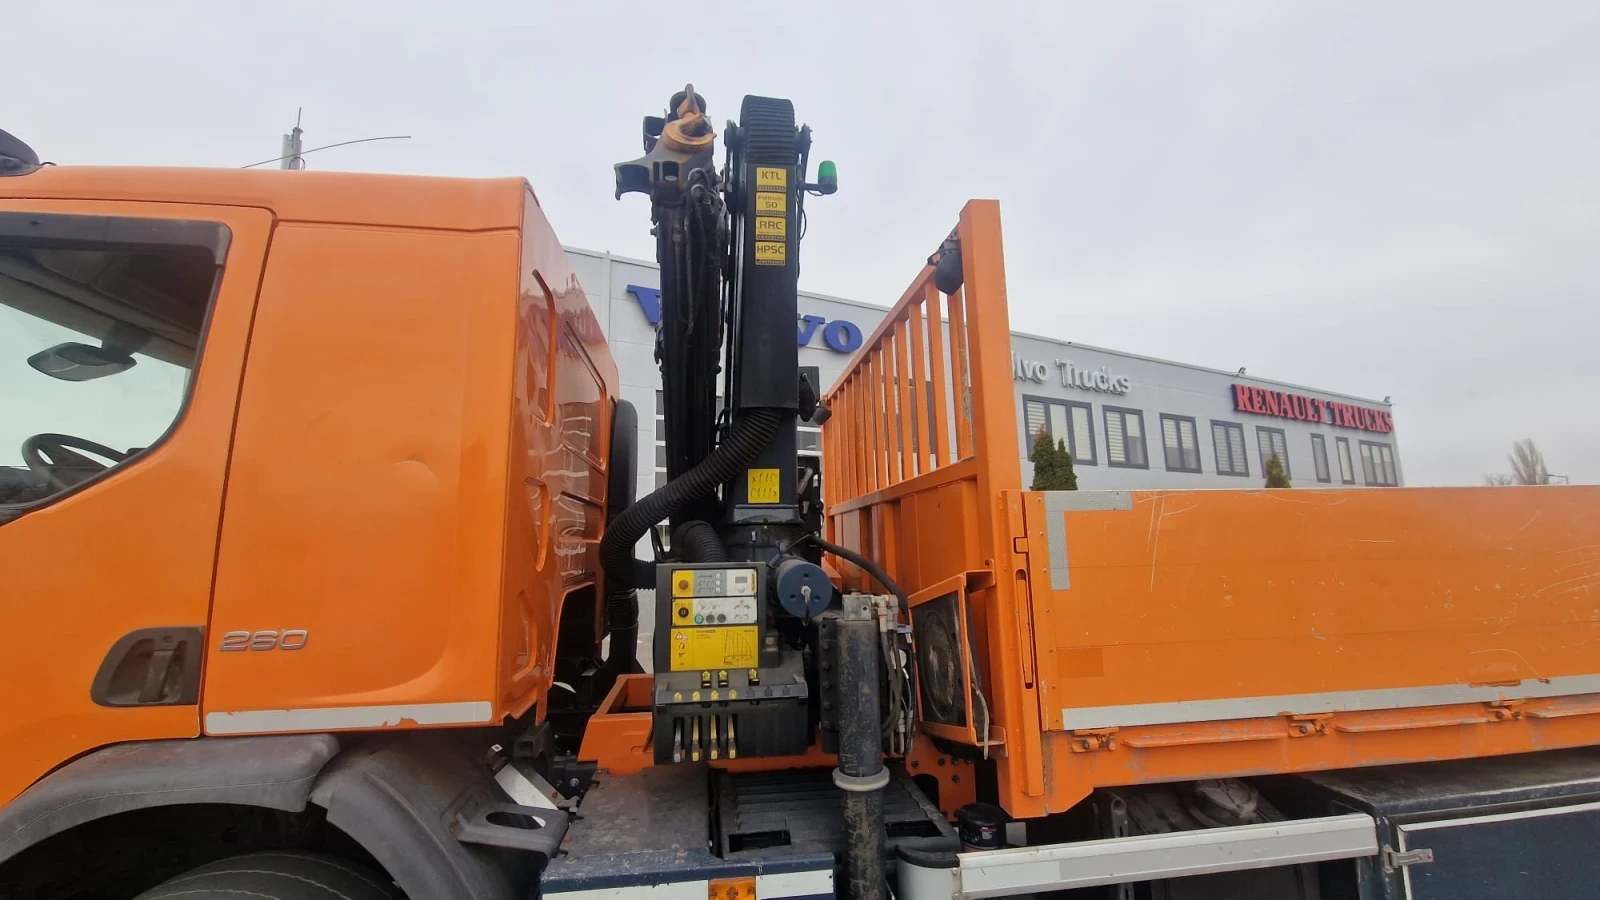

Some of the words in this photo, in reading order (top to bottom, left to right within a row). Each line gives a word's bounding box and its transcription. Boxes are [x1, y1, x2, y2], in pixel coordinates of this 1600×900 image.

[761, 170, 782, 181] KTL
[759, 220, 783, 230] RRC
[757, 244, 785, 255] HPSC
[1055, 358, 1131, 396] Trucks
[1231, 383, 1328, 424] RENAULT
[1327, 400, 1395, 434] TRUCKS
[219, 629, 309, 651] 260
